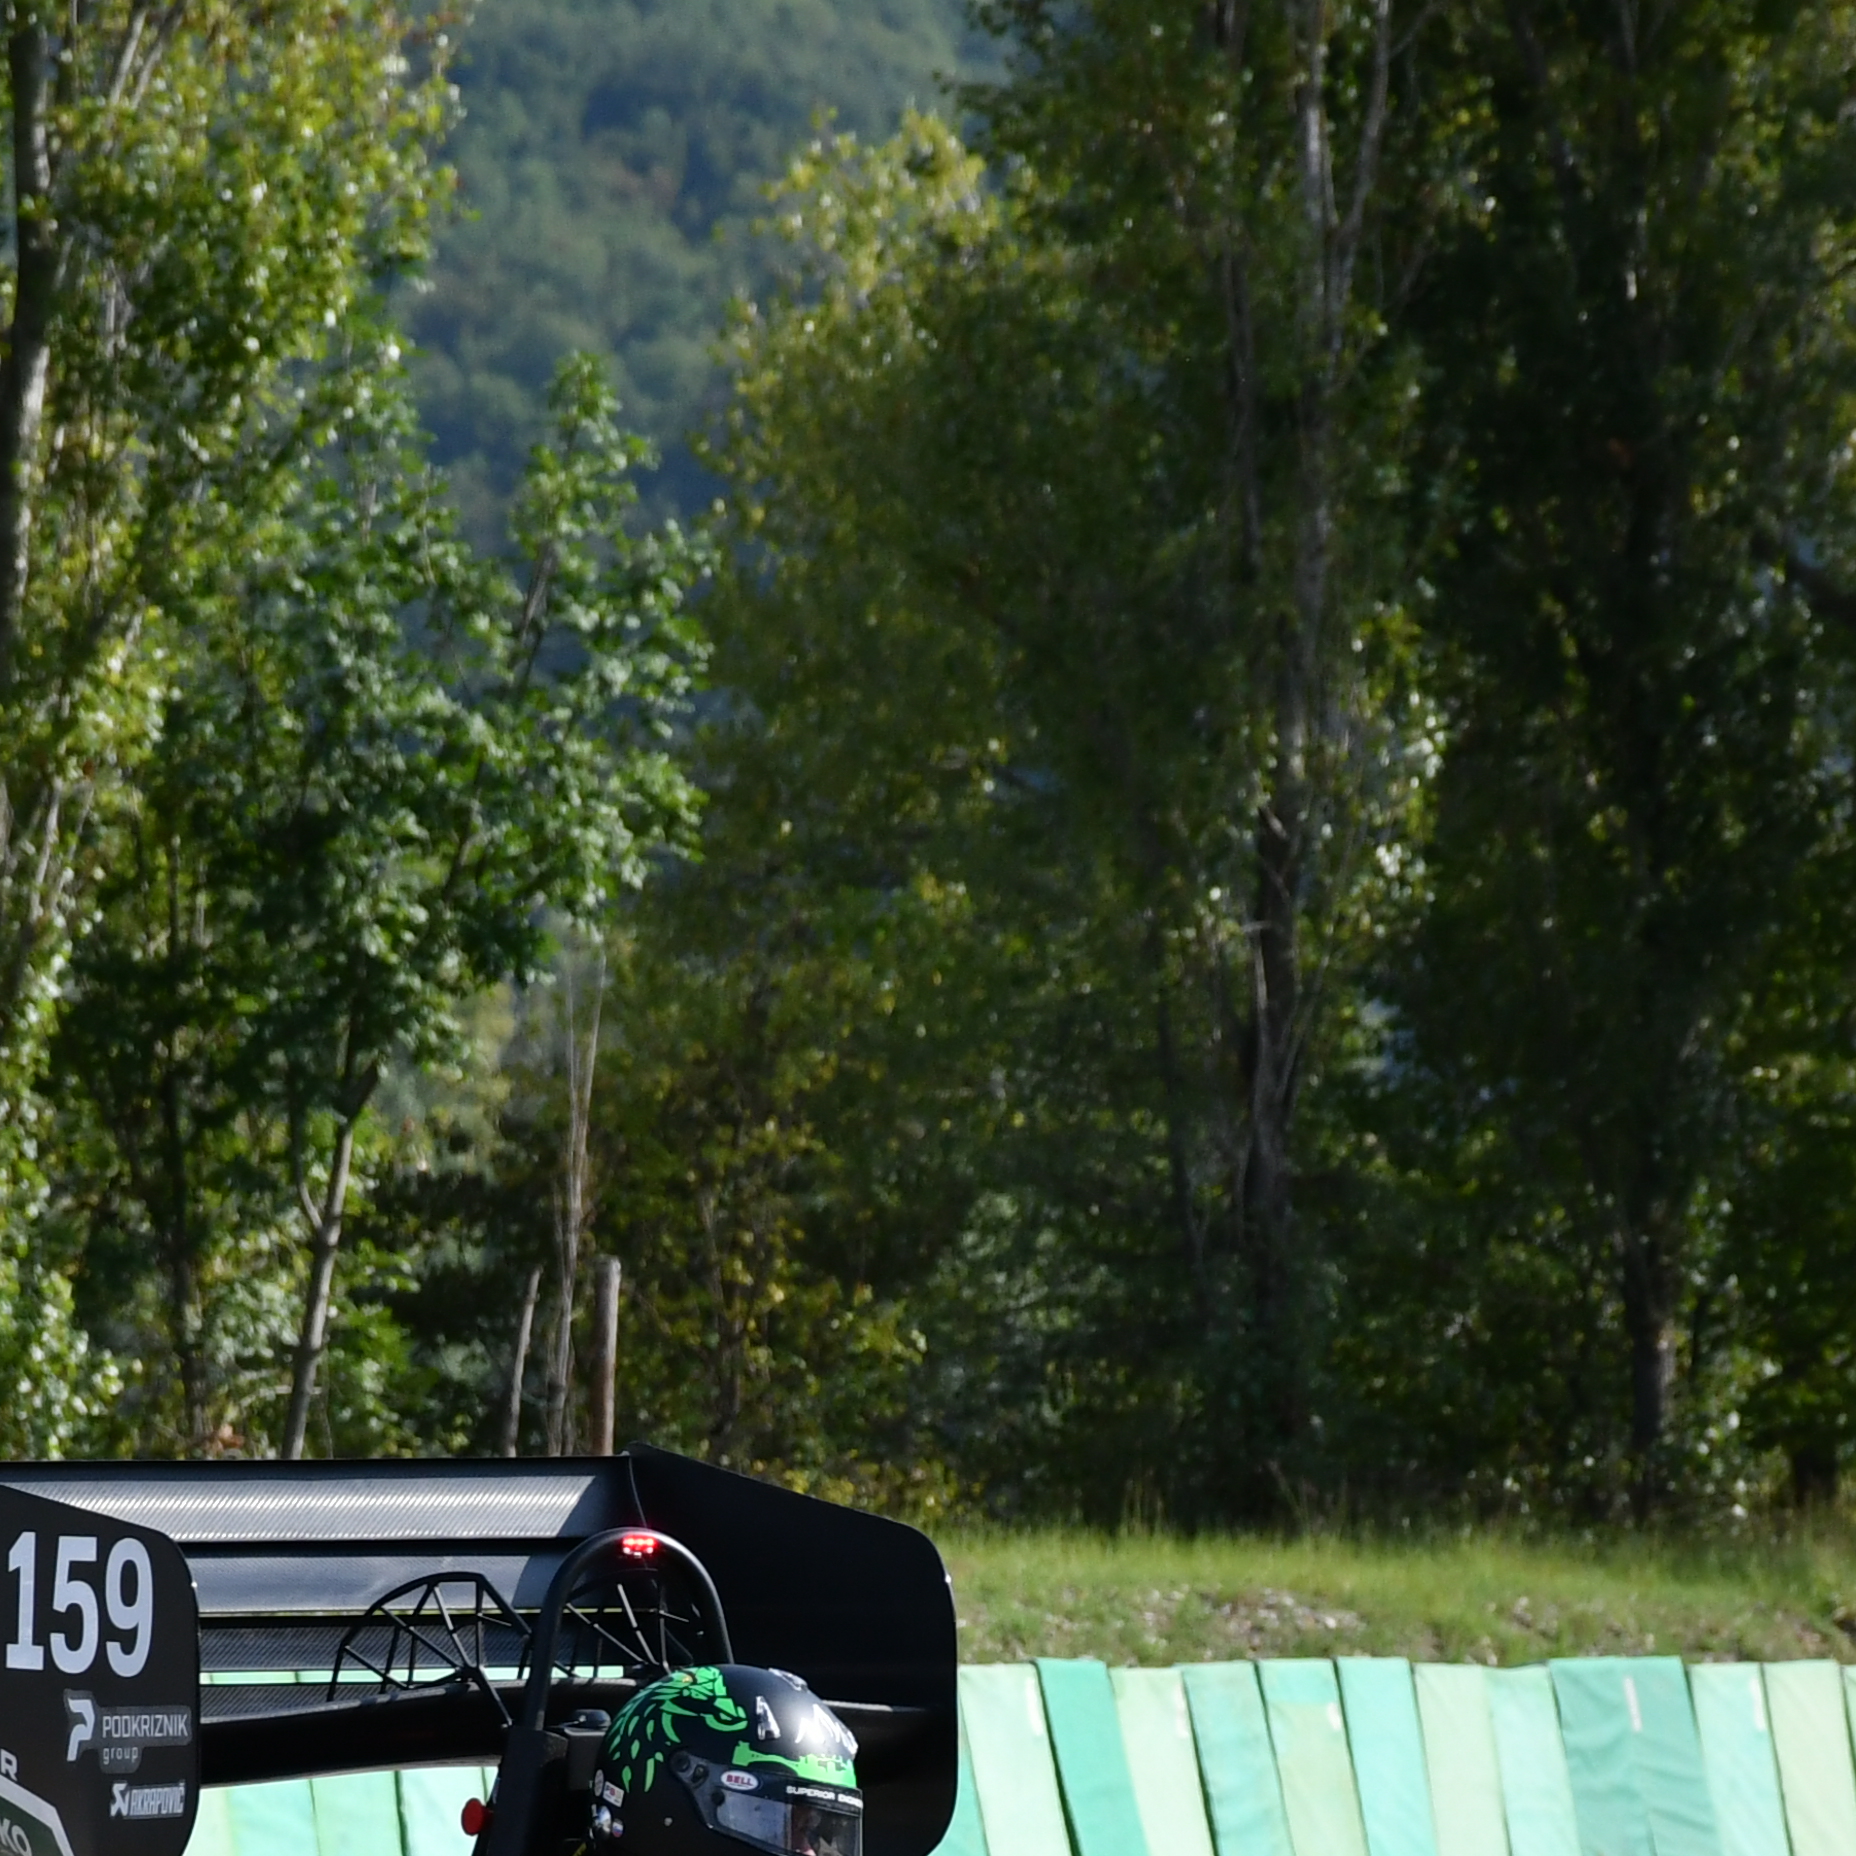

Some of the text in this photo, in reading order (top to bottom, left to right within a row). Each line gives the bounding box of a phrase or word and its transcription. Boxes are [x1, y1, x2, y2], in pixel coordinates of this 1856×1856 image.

[5, 1531, 154, 1678] 159
[102, 1746, 139, 1765] group
[726, 1774, 755, 1788] BELL
[785, 1785, 836, 1801] SUPERIOR
